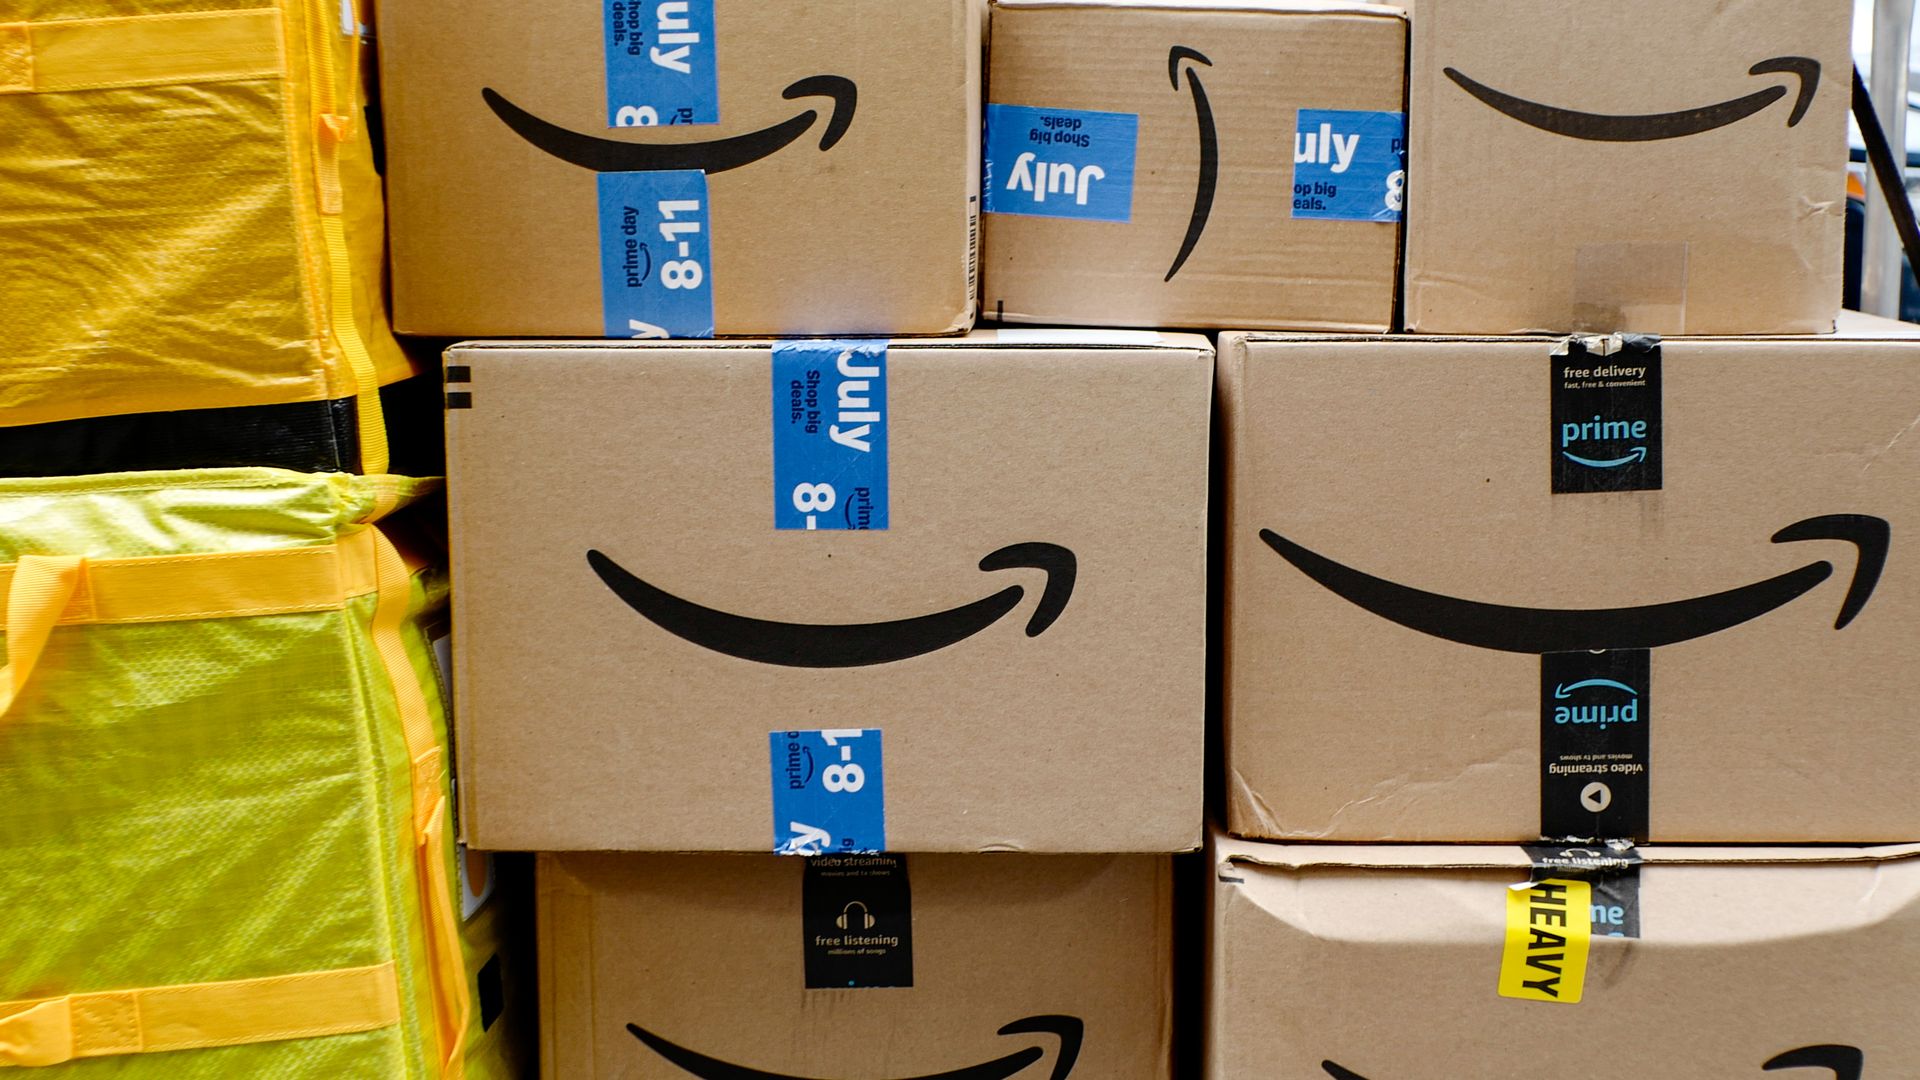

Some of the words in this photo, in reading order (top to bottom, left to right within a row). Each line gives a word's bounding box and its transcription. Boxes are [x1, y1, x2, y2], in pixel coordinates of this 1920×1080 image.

[613, 2, 627, 46] deals.
[627, 0, 642, 29] hop
[627, 32, 643, 55] big
[1030, 129, 1051, 144] big
[1040, 116, 1082, 131] deals.
[1054, 131, 1090, 147] Shop
[1006, 152, 1105, 205] July
[1314, 181, 1337, 197] big
[621, 206, 639, 235] day
[658, 200, 703, 289] 8-11
[622, 239, 642, 288] prime
[1563, 366, 1590, 378] free
[1593, 365, 1646, 378] delivery
[791, 380, 805, 424] deals.
[805, 369, 821, 408] Shop
[829, 349, 880, 452] July
[805, 411, 821, 434] big
[1562, 415, 1647, 448] prime
[1555, 698, 1638, 730] prime
[785, 743, 805, 789] prime
[1549, 763, 1608, 776] streaming
[1610, 763, 1643, 775] video
[811, 857, 841, 867] video
[816, 935, 840, 946] free
[844, 934, 898, 947] listening
[1522, 883, 1566, 998] HEAVY
